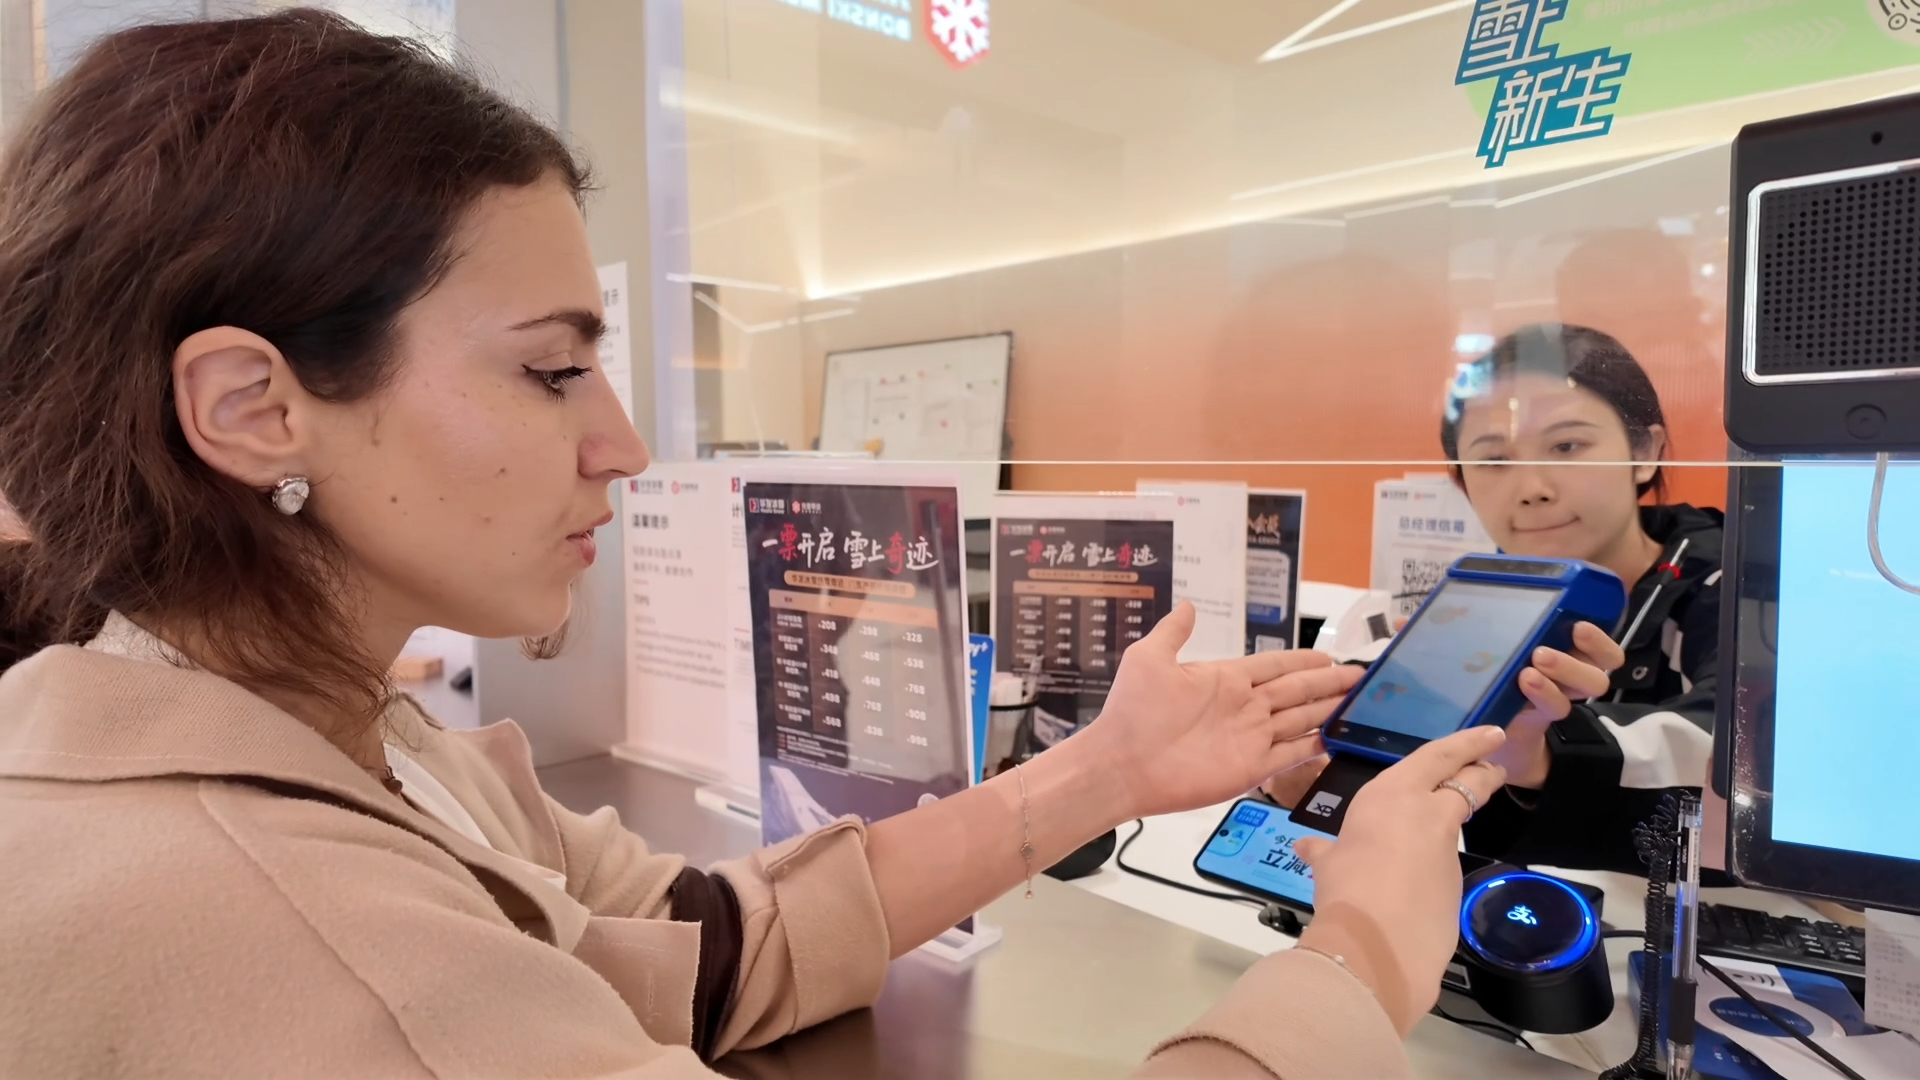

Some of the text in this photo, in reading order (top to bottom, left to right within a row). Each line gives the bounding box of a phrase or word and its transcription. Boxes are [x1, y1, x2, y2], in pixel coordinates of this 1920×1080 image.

[1487, 55, 1623, 163] 新生
[761, 523, 836, 569] 一票开启
[843, 530, 940, 575] 雪上奇迹
[1009, 539, 1076, 567] 一票开启
[1081, 542, 1159, 569] 雪上奇迹
